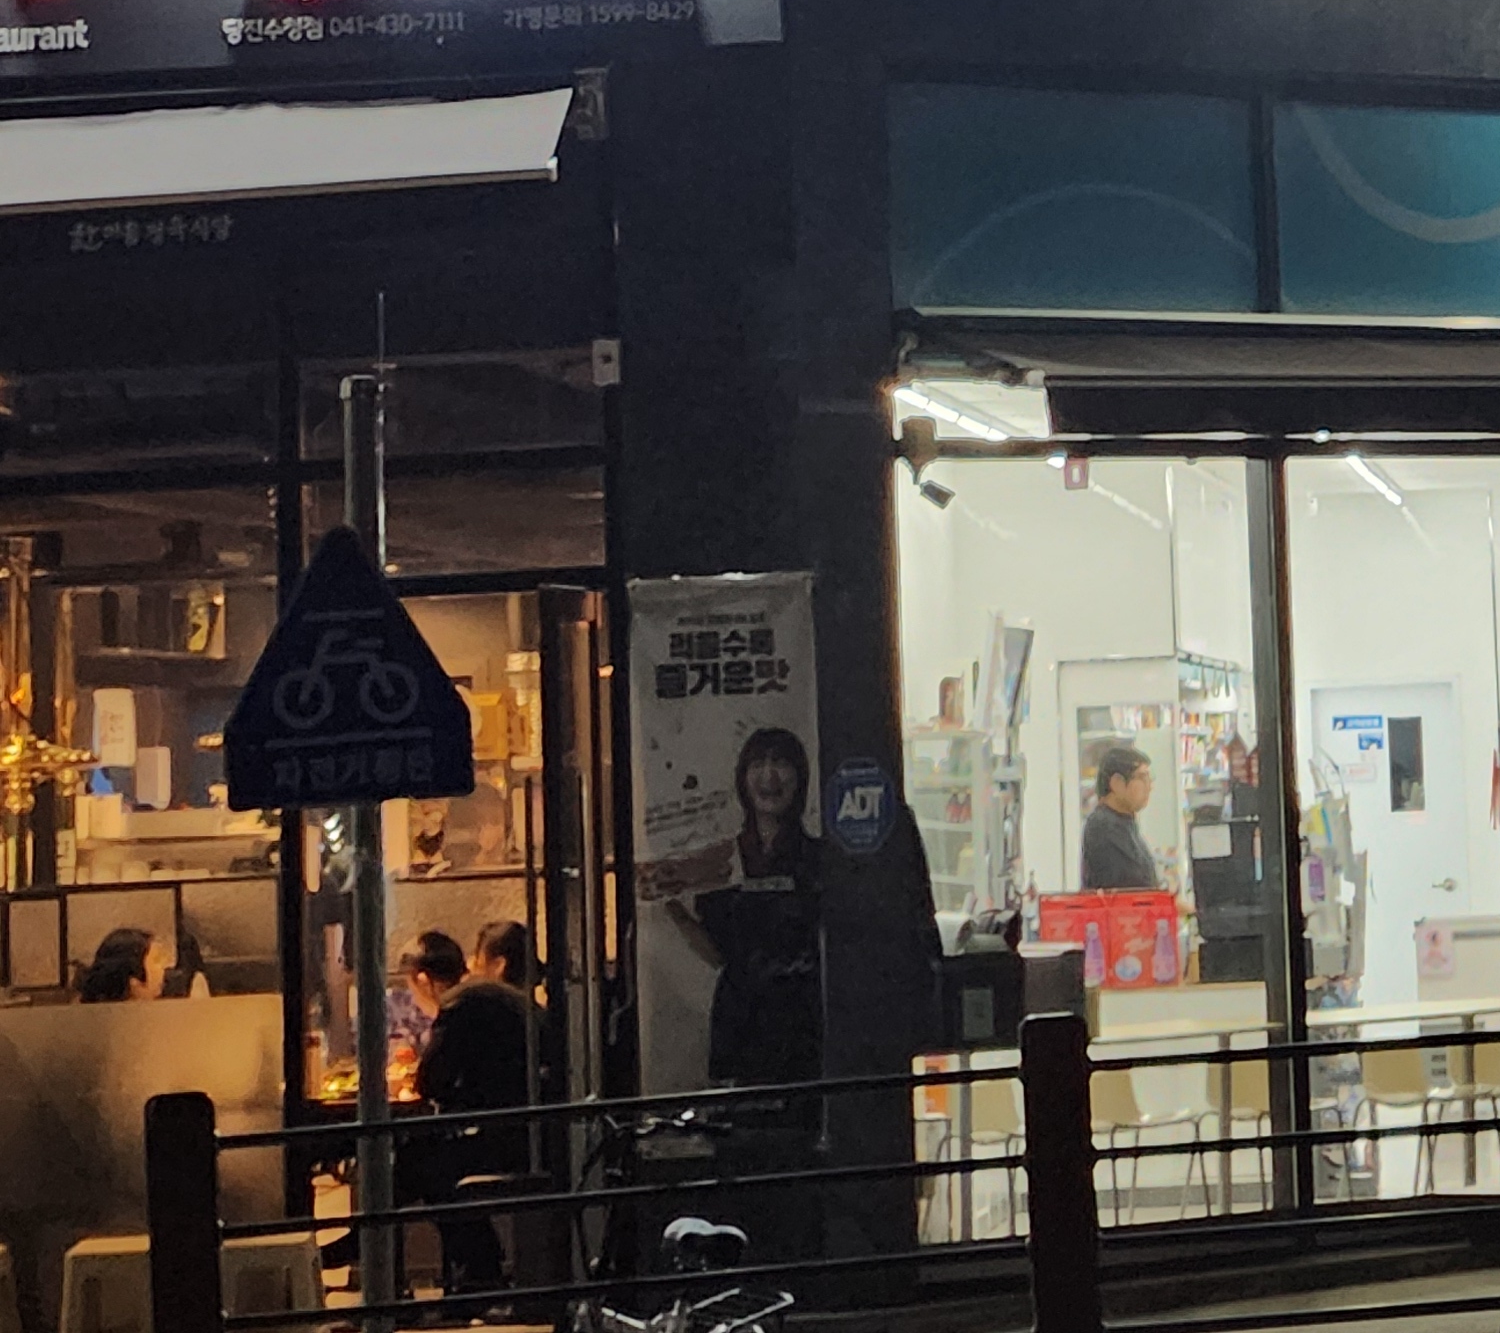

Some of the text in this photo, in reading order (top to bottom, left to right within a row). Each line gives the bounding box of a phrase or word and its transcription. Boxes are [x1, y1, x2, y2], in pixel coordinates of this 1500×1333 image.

[222, 14, 325, 45] 당진수청점
[329, 10, 465, 37] 041-430-7111
[836, 785, 886, 823] ADT
